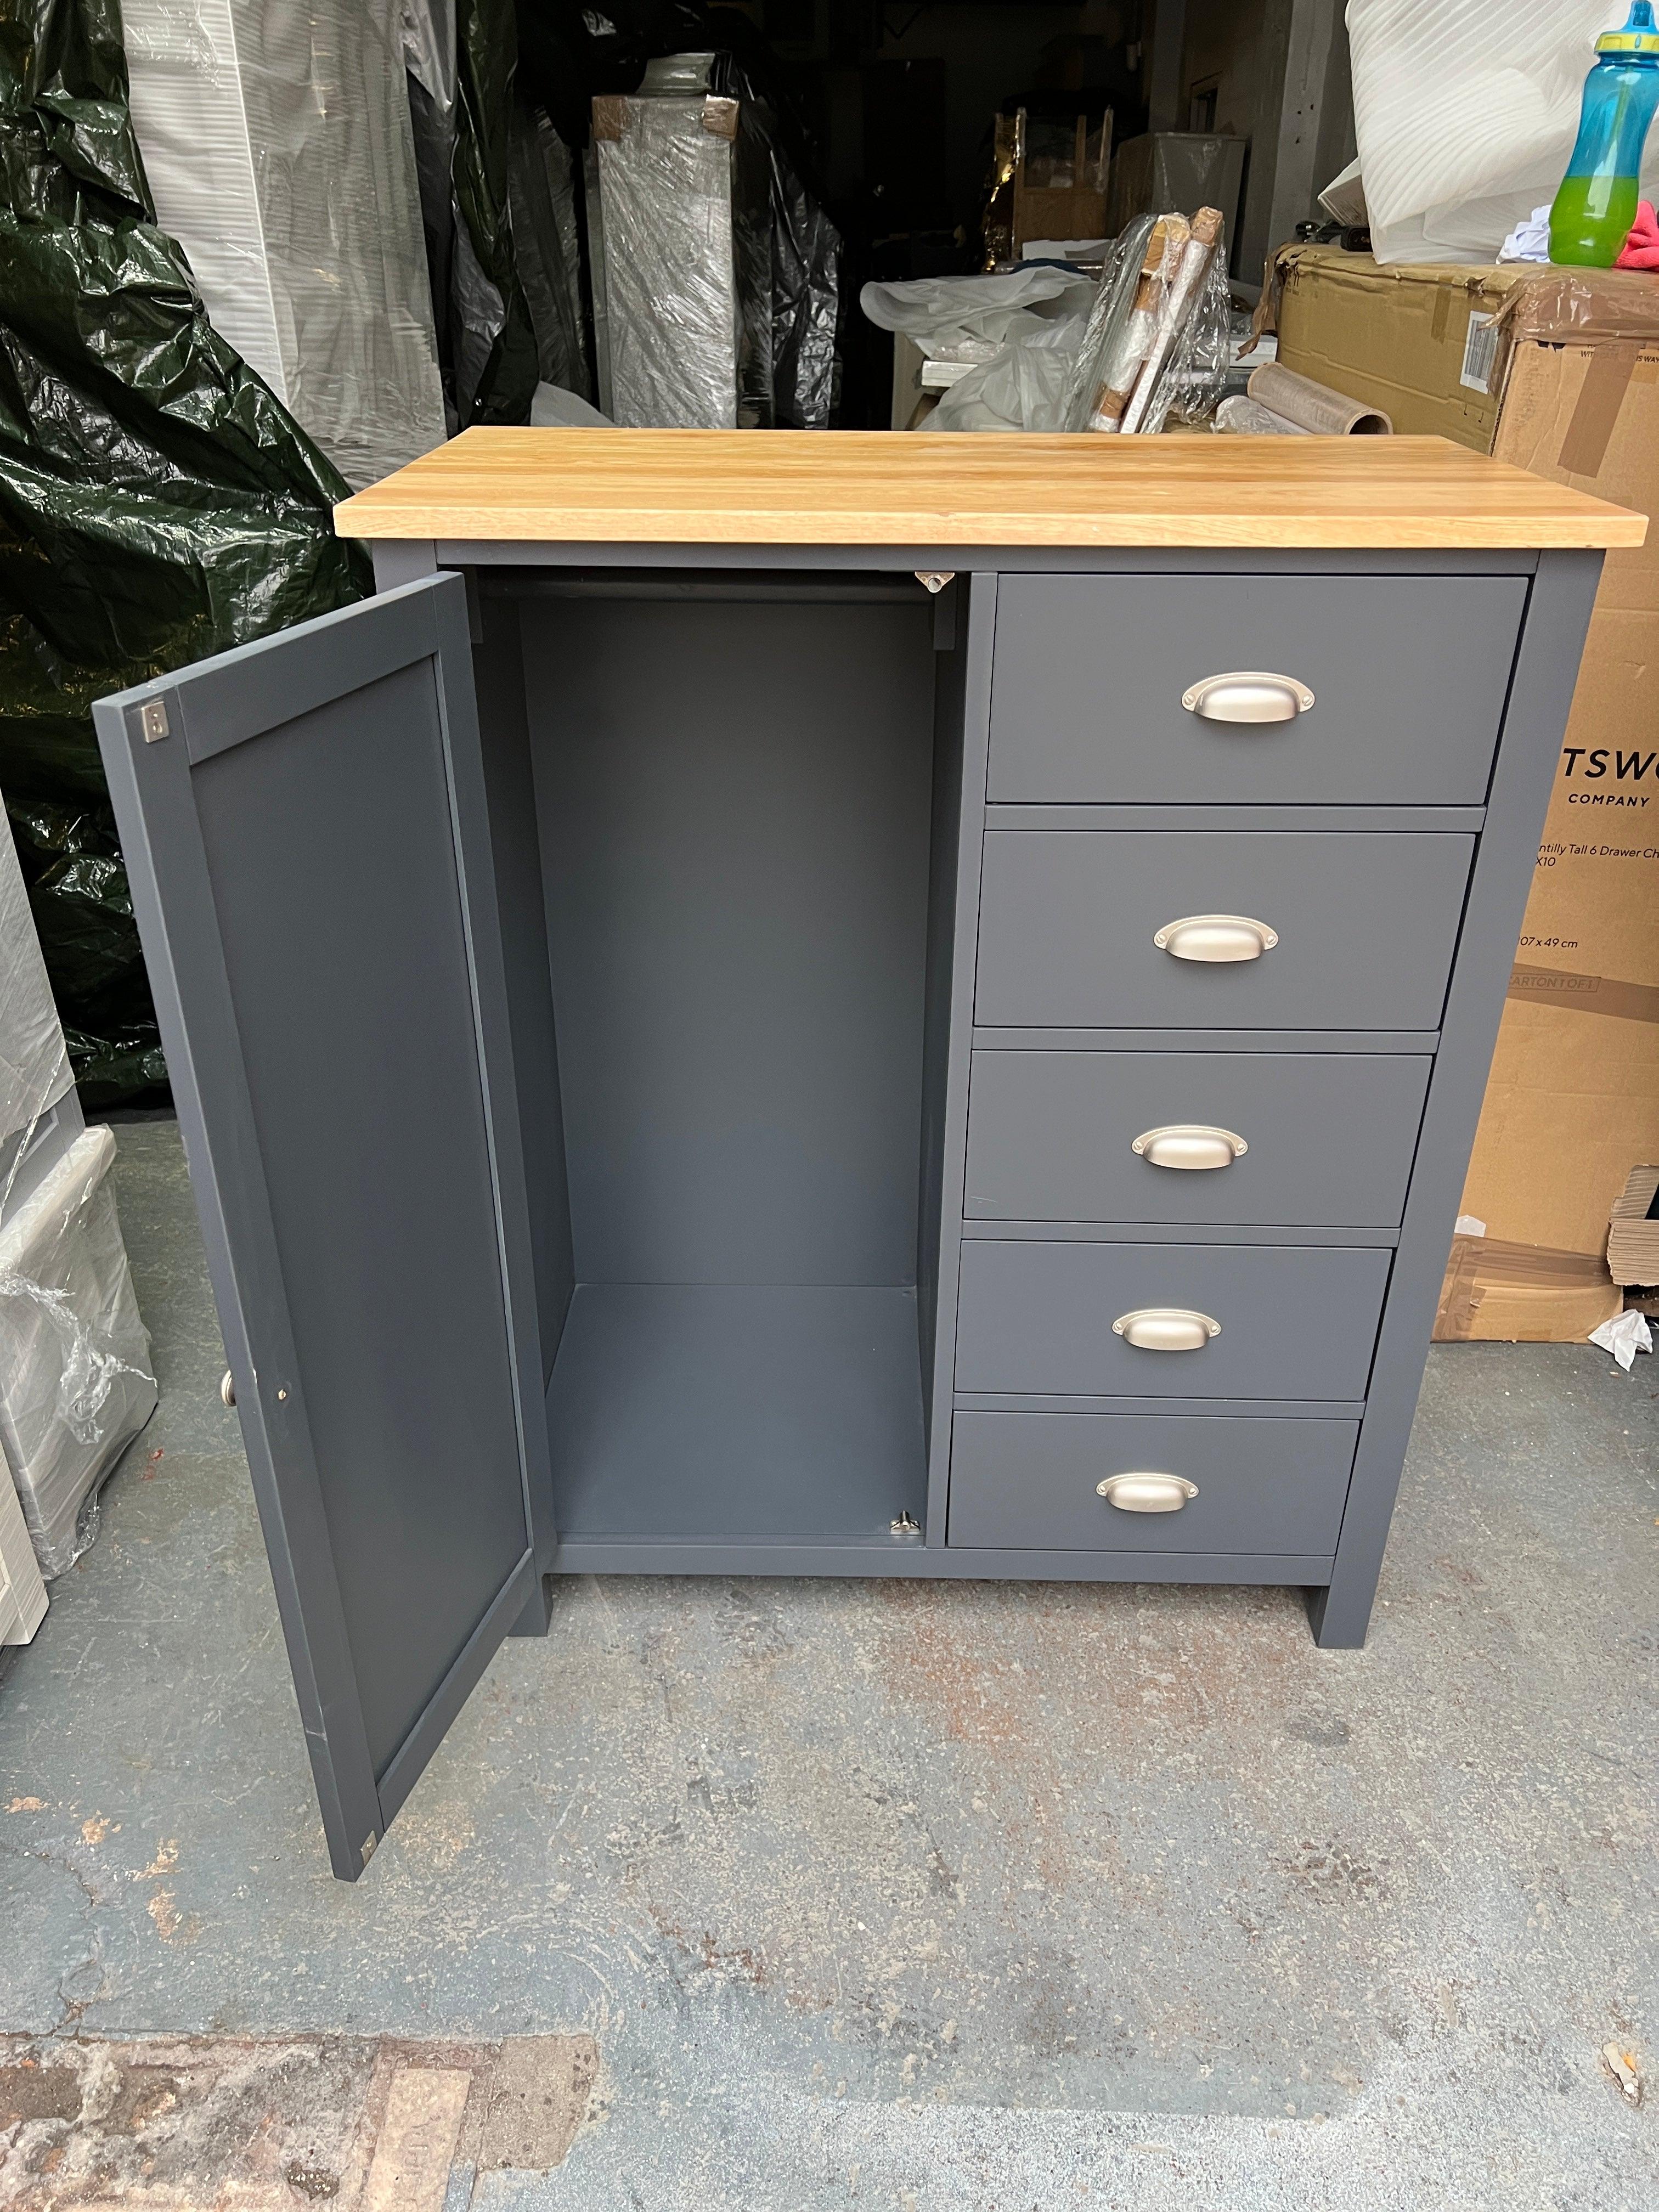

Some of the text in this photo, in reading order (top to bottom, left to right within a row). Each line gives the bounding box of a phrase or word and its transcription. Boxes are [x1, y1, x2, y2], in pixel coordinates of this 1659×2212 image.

[1564, 748, 1659, 780] TSW
[1568, 794, 1650, 807] COMPANY
[1569, 844, 1588, 854] Tall
[1589, 845, 1597, 855] 6
[1600, 846, 1641, 857] Drawer
[1519, 936, 1536, 946] 07
[1544, 938, 1559, 947] 49
[1561, 940, 1578, 949] cm
[1510, 975, 1558, 988] ARTON
[1567, 978, 1587, 989] OF
